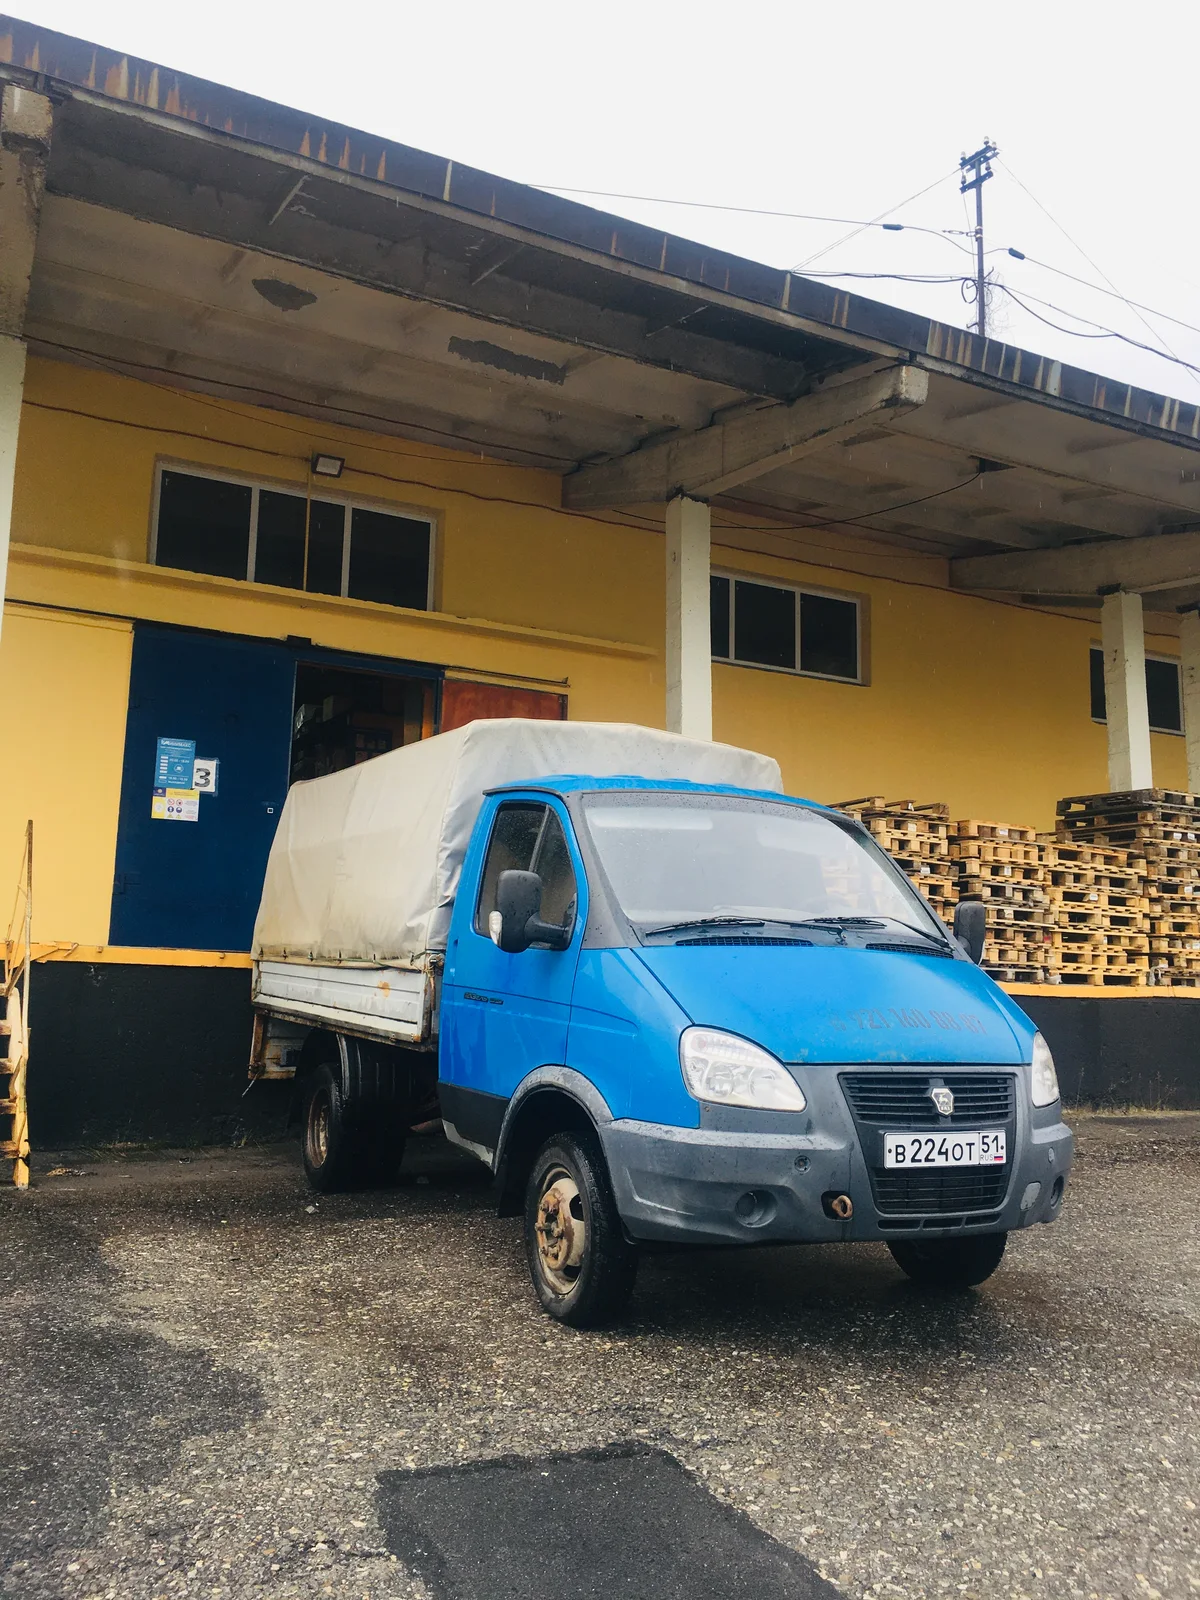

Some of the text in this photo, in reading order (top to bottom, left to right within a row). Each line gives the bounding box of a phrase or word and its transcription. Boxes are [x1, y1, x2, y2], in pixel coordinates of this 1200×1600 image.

[195, 768, 211, 788] 3
[981, 1135, 999, 1153] 51
[980, 1153, 994, 1161] RUS
